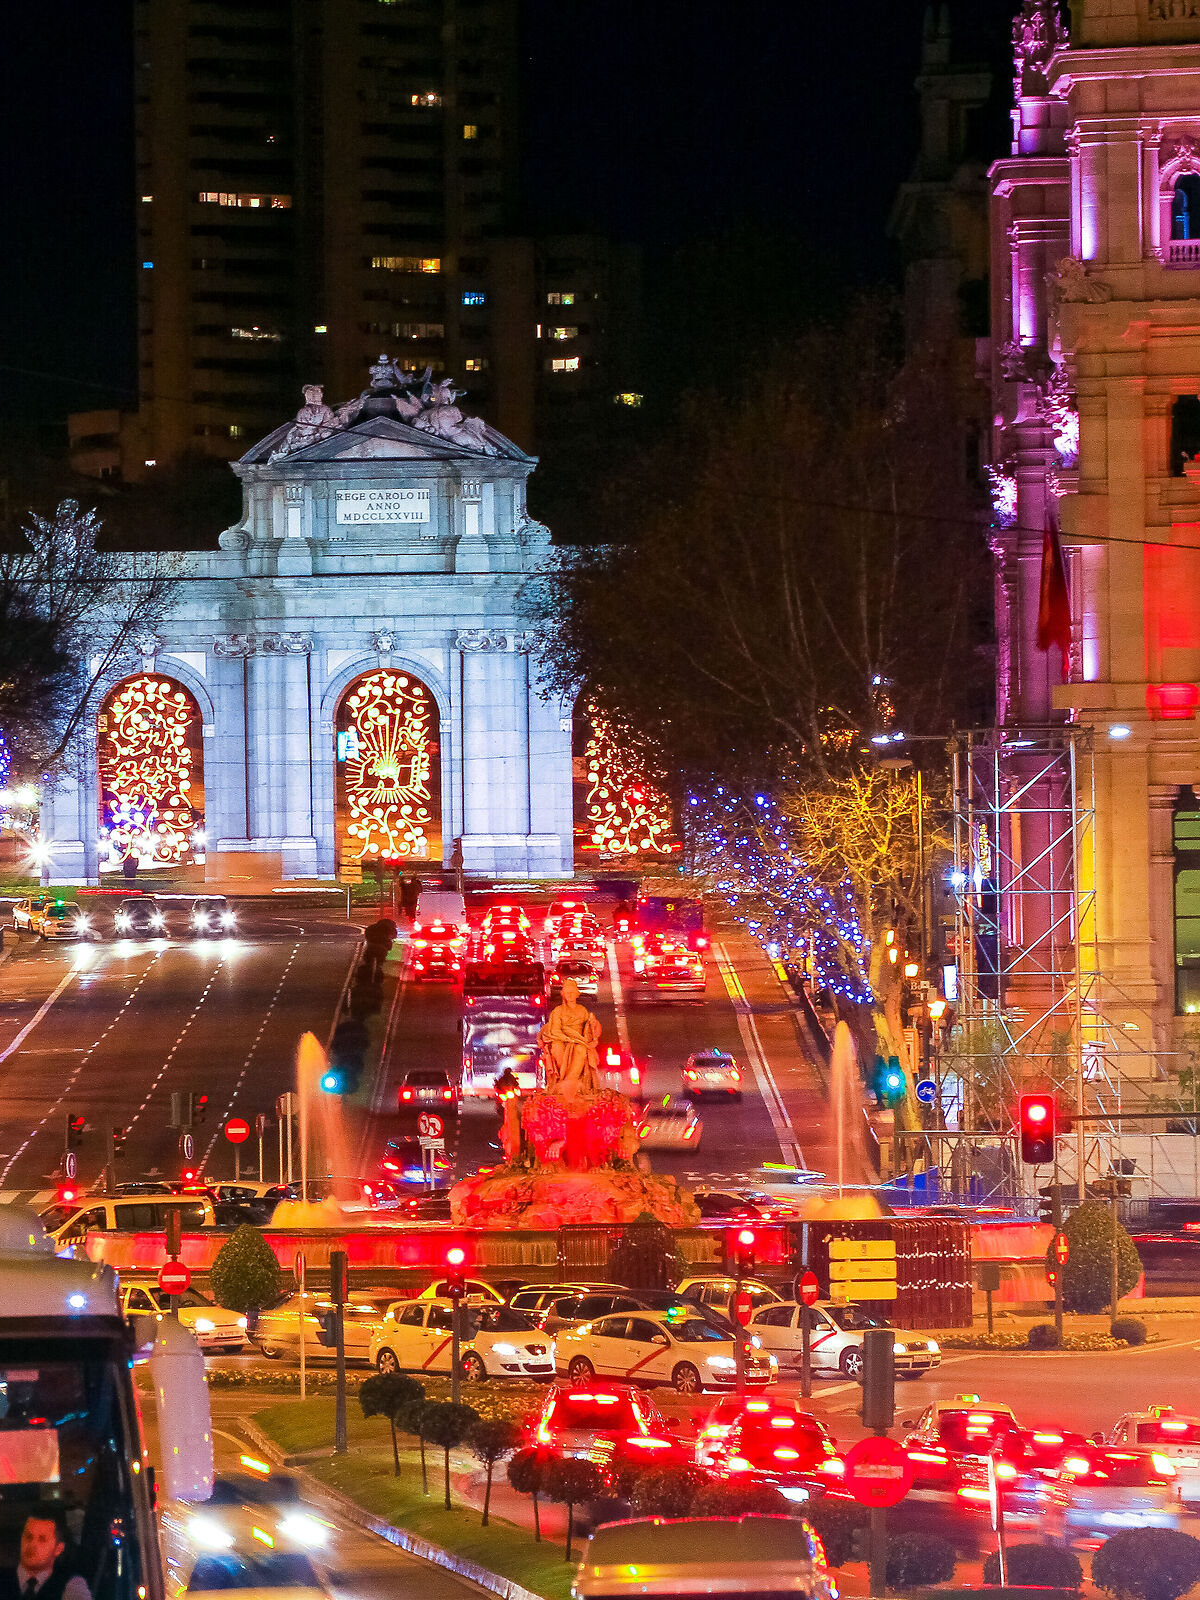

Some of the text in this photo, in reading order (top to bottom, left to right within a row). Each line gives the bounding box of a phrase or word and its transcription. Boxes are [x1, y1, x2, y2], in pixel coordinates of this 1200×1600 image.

[337, 492, 430, 501] REGE CAROLO III
[366, 502, 401, 510] ANNO
[343, 512, 423, 521] MDCCLXXVIII
